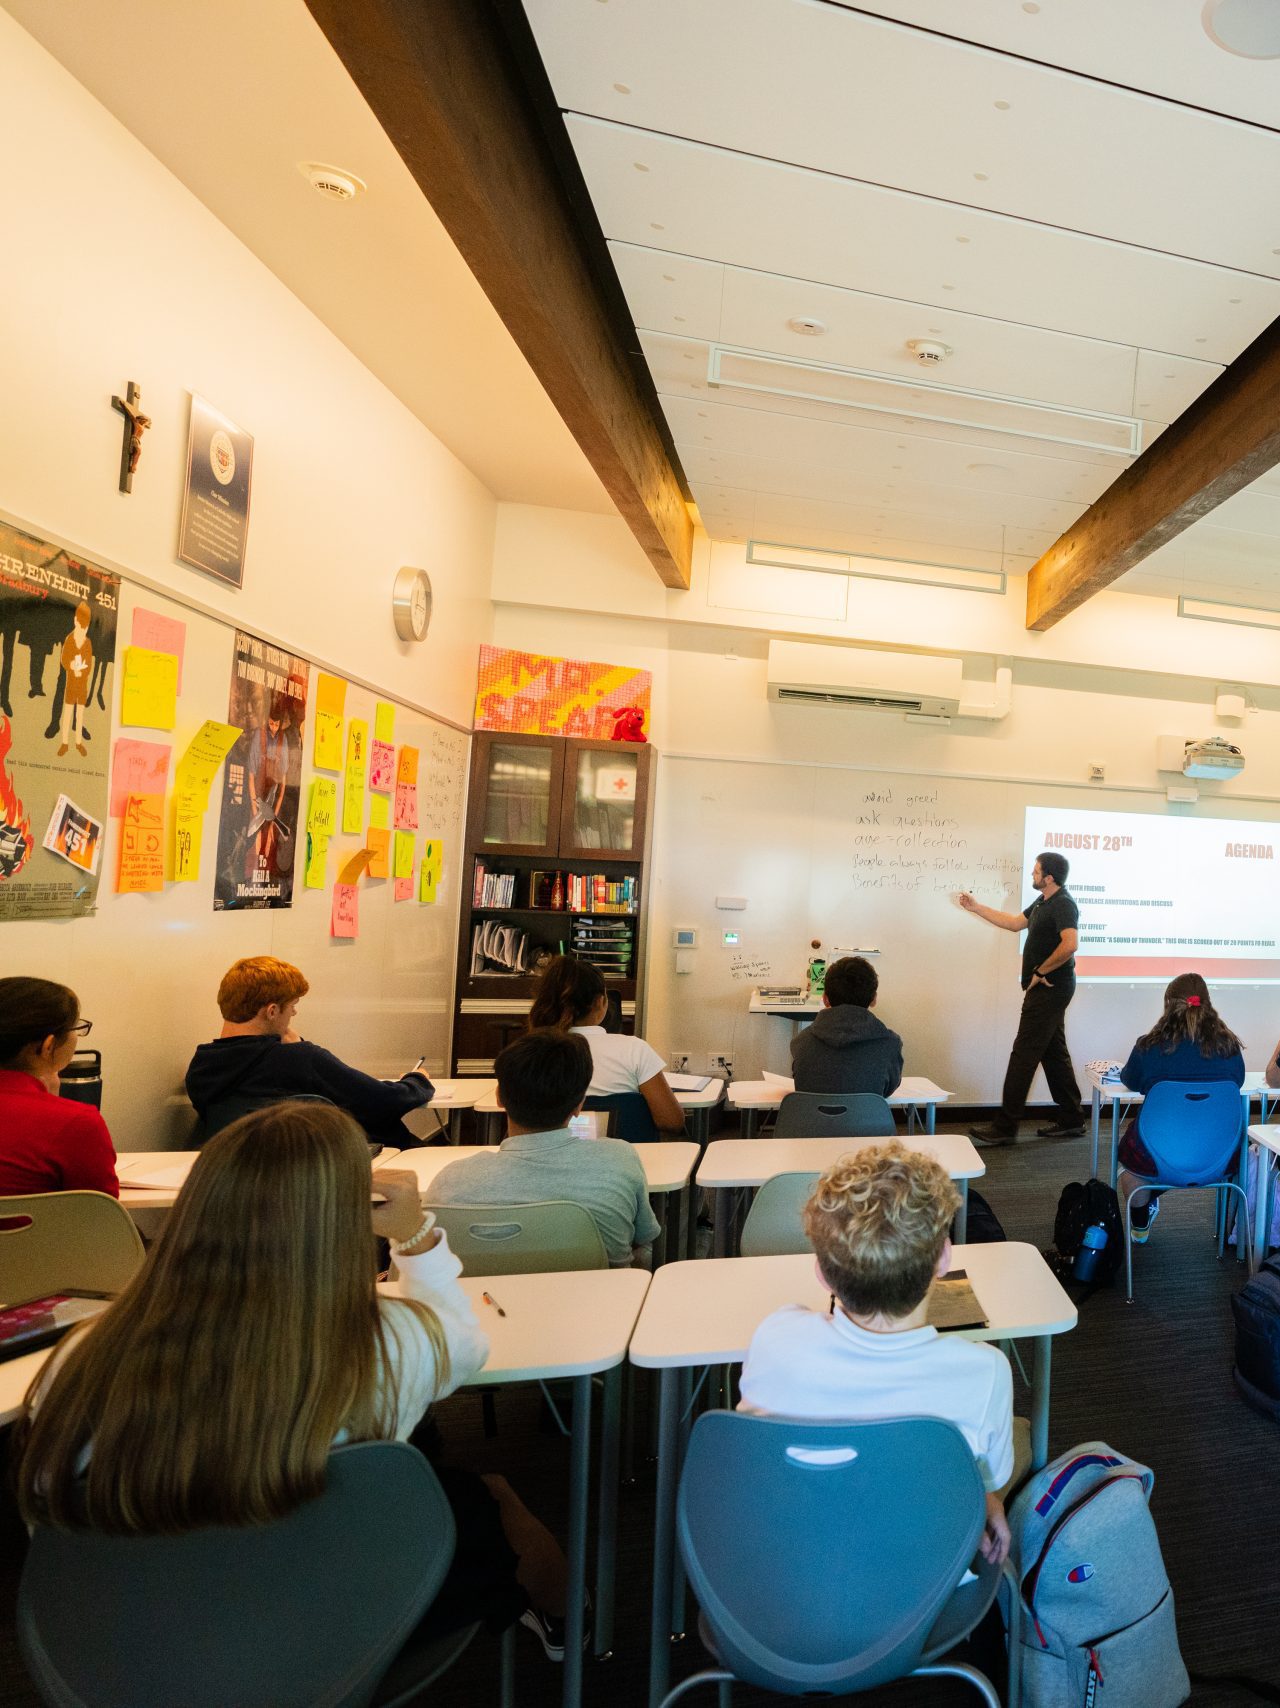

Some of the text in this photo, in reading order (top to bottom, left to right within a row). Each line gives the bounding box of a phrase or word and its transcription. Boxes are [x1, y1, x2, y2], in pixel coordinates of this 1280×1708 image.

[96, 592, 116, 610] 451
[862, 789, 893, 803] avoid
[855, 810, 960, 828] ask questions
[65, 828, 88, 856] 451
[1044, 832, 1100, 850] AUGUST
[1225, 843, 1274, 859] AGENDA
[258, 855, 267, 867] To
[252, 869, 265, 882] Kill
[236, 883, 281, 899] Mockingbird
